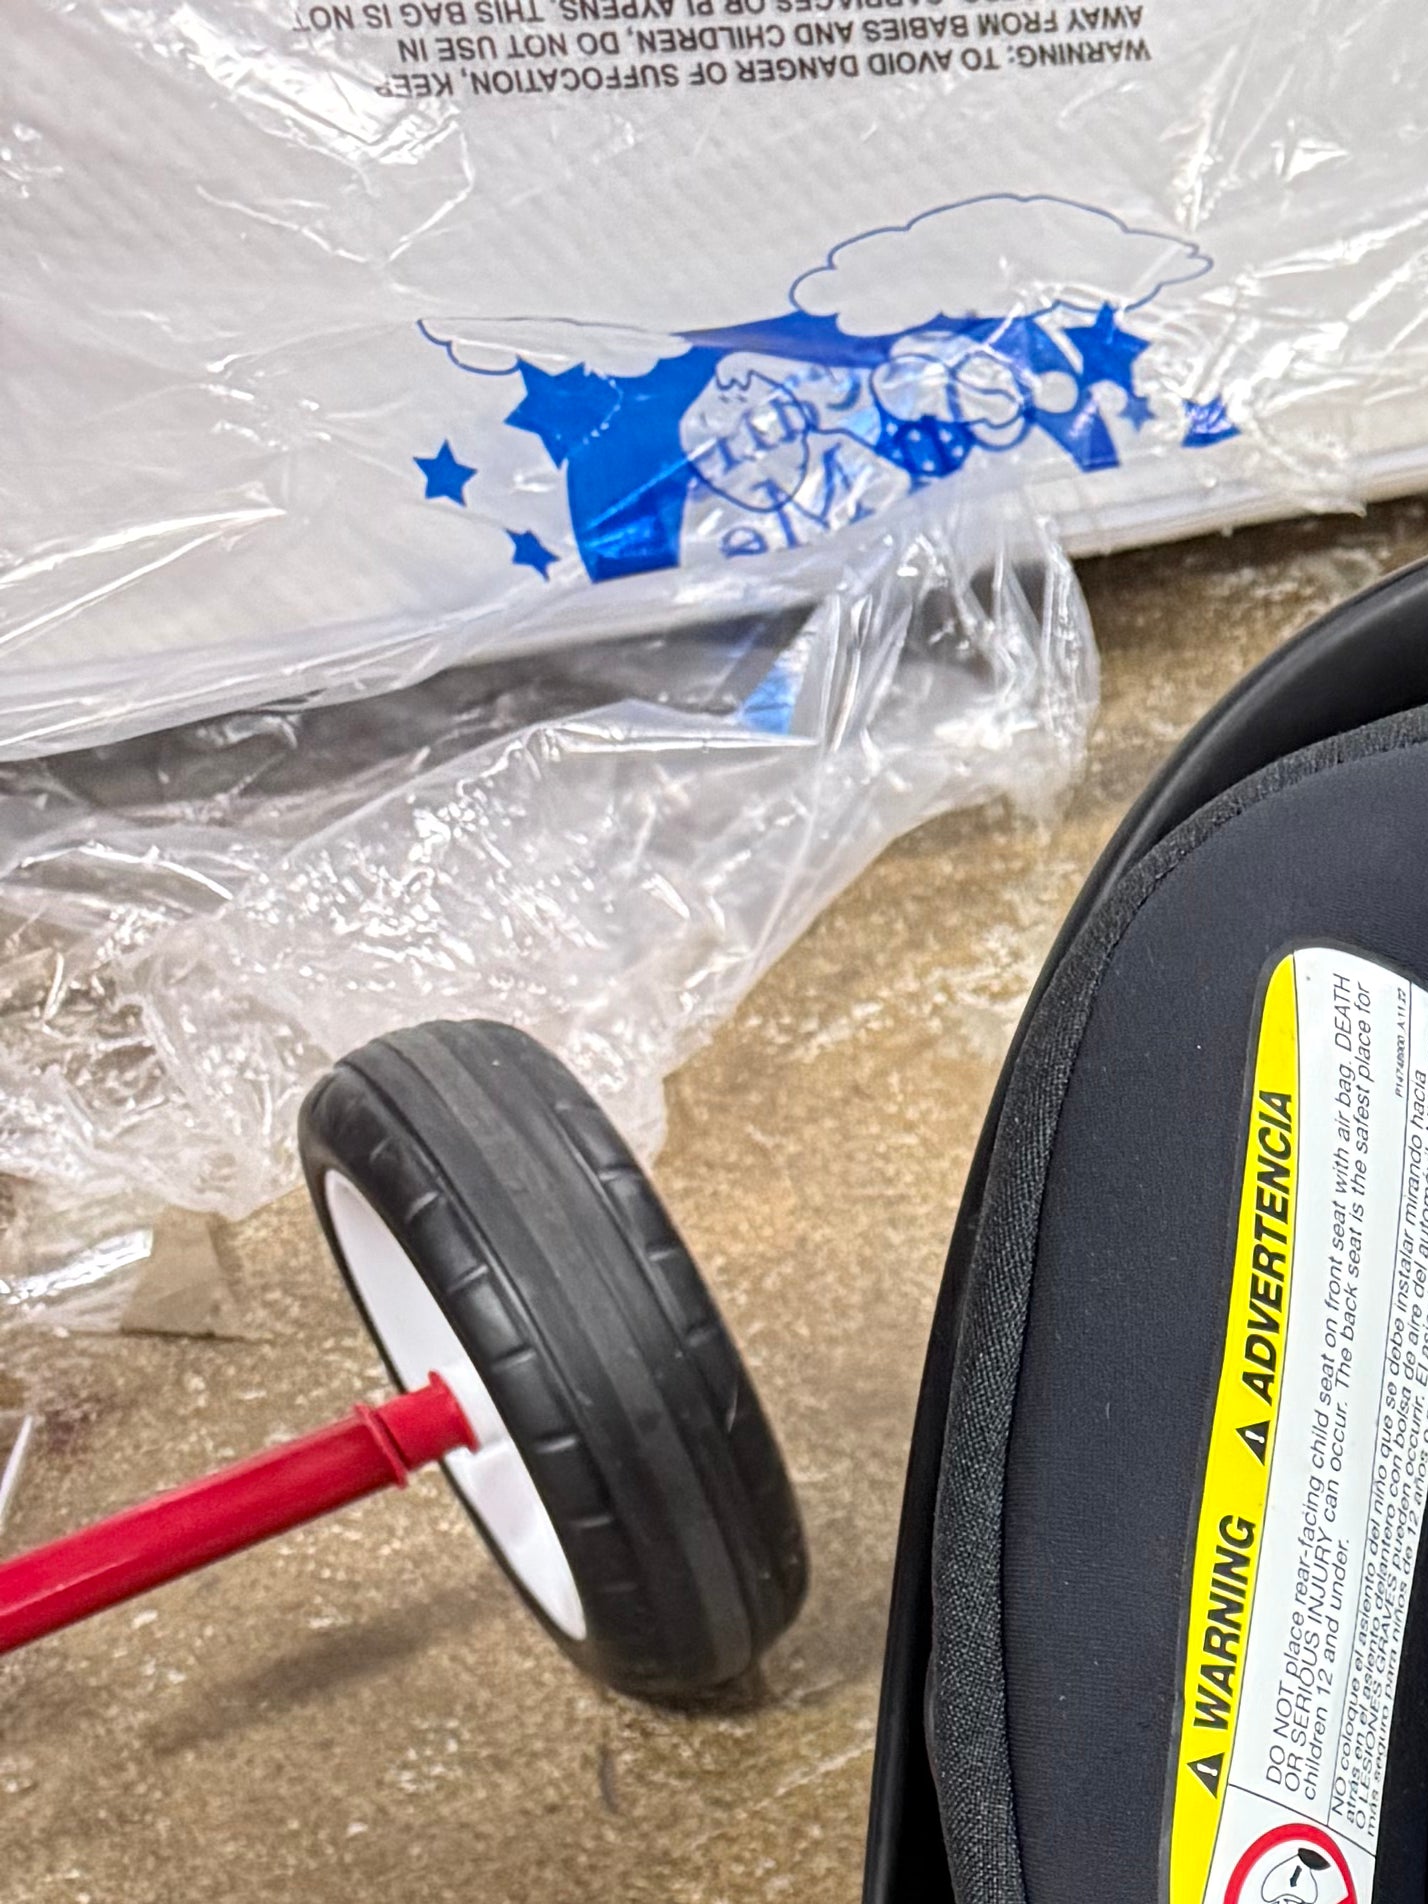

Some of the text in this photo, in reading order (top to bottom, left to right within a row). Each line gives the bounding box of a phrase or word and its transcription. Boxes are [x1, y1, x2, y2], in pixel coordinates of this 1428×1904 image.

[361, 3, 391, 28] IS
[398, 0, 467, 26] BAG
[473, 0, 539, 23] THIS
[396, 4, 1143, 63] AWAY FROM BABIES AND CHILDREN, DO NOT USE IN
[734, 54, 859, 83] DANGER
[866, 49, 953, 76] AVOID
[959, 47, 998, 72] TO
[1006, 38, 1151, 68] WARNING:
[460, 62, 679, 95] SUFFOCATION,
[688, 61, 728, 86] OF
[1241, 1089, 1292, 1406] ADVERTENCIA
[1265, 972, 1356, 1785] DO NOT place rear-facing child seat on front seat with air bag. DEATH
[1284, 980, 1375, 1792] OR SERIOUS INJURY can occur. The back seat is the safest place for
[1330, 1069, 1426, 1816] NO coloque el asiento del niño que se debe instalar mirando hacia
[1192, 1514, 1256, 1730] WARNING
[1302, 1539, 1349, 1800] children 12 and under.
